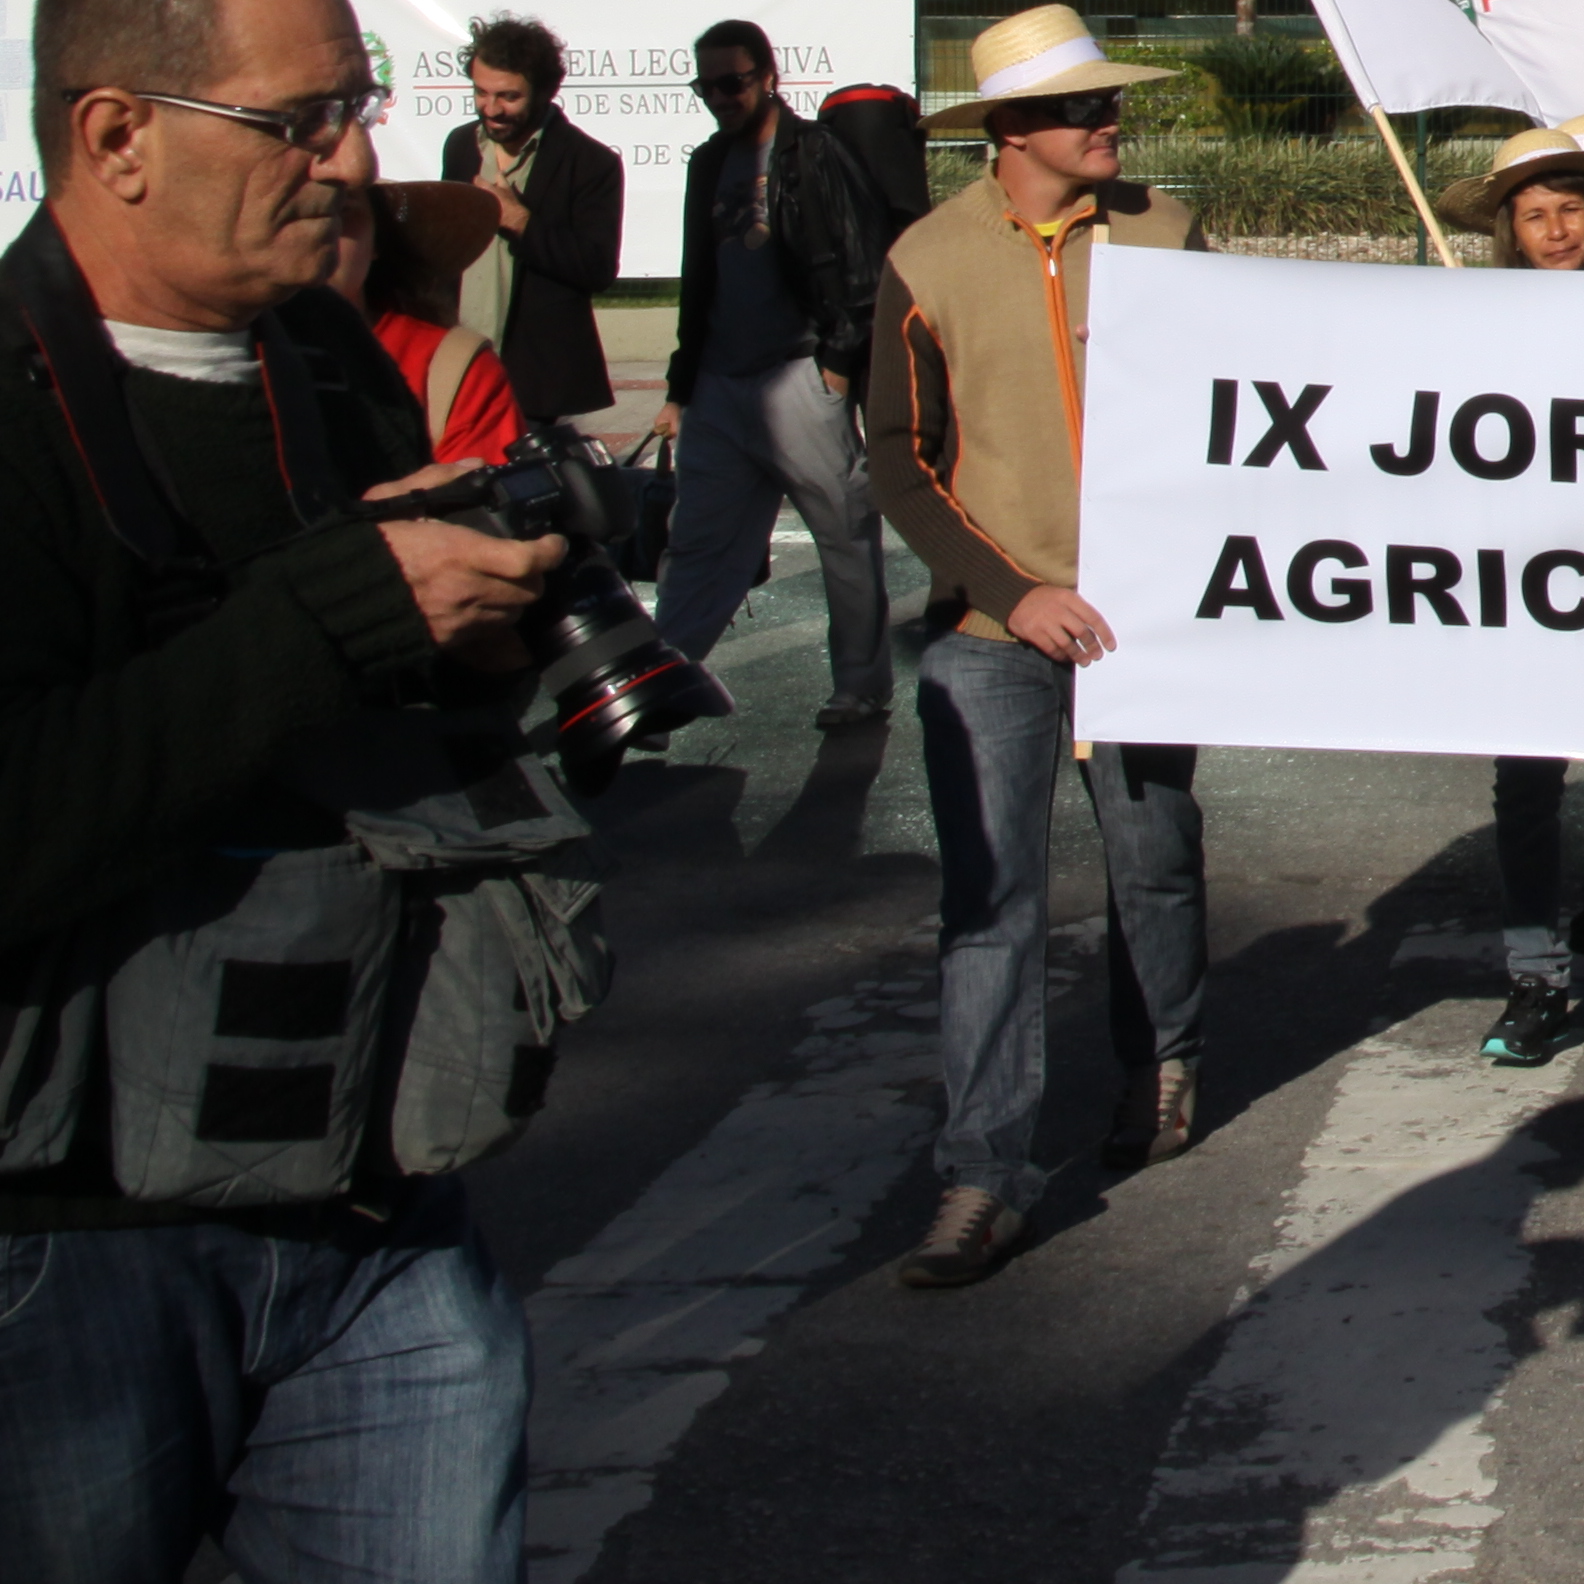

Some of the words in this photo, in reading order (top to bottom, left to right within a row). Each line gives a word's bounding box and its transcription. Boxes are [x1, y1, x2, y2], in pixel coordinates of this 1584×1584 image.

[413, 49, 624, 78] ASSEIA
[629, 46, 835, 77] LEGIVA
[416, 95, 452, 117] DO
[576, 94, 611, 115] DE
[619, 92, 702, 115] SANTA
[633, 145, 672, 166] DE
[1205, 378, 1335, 472] IX
